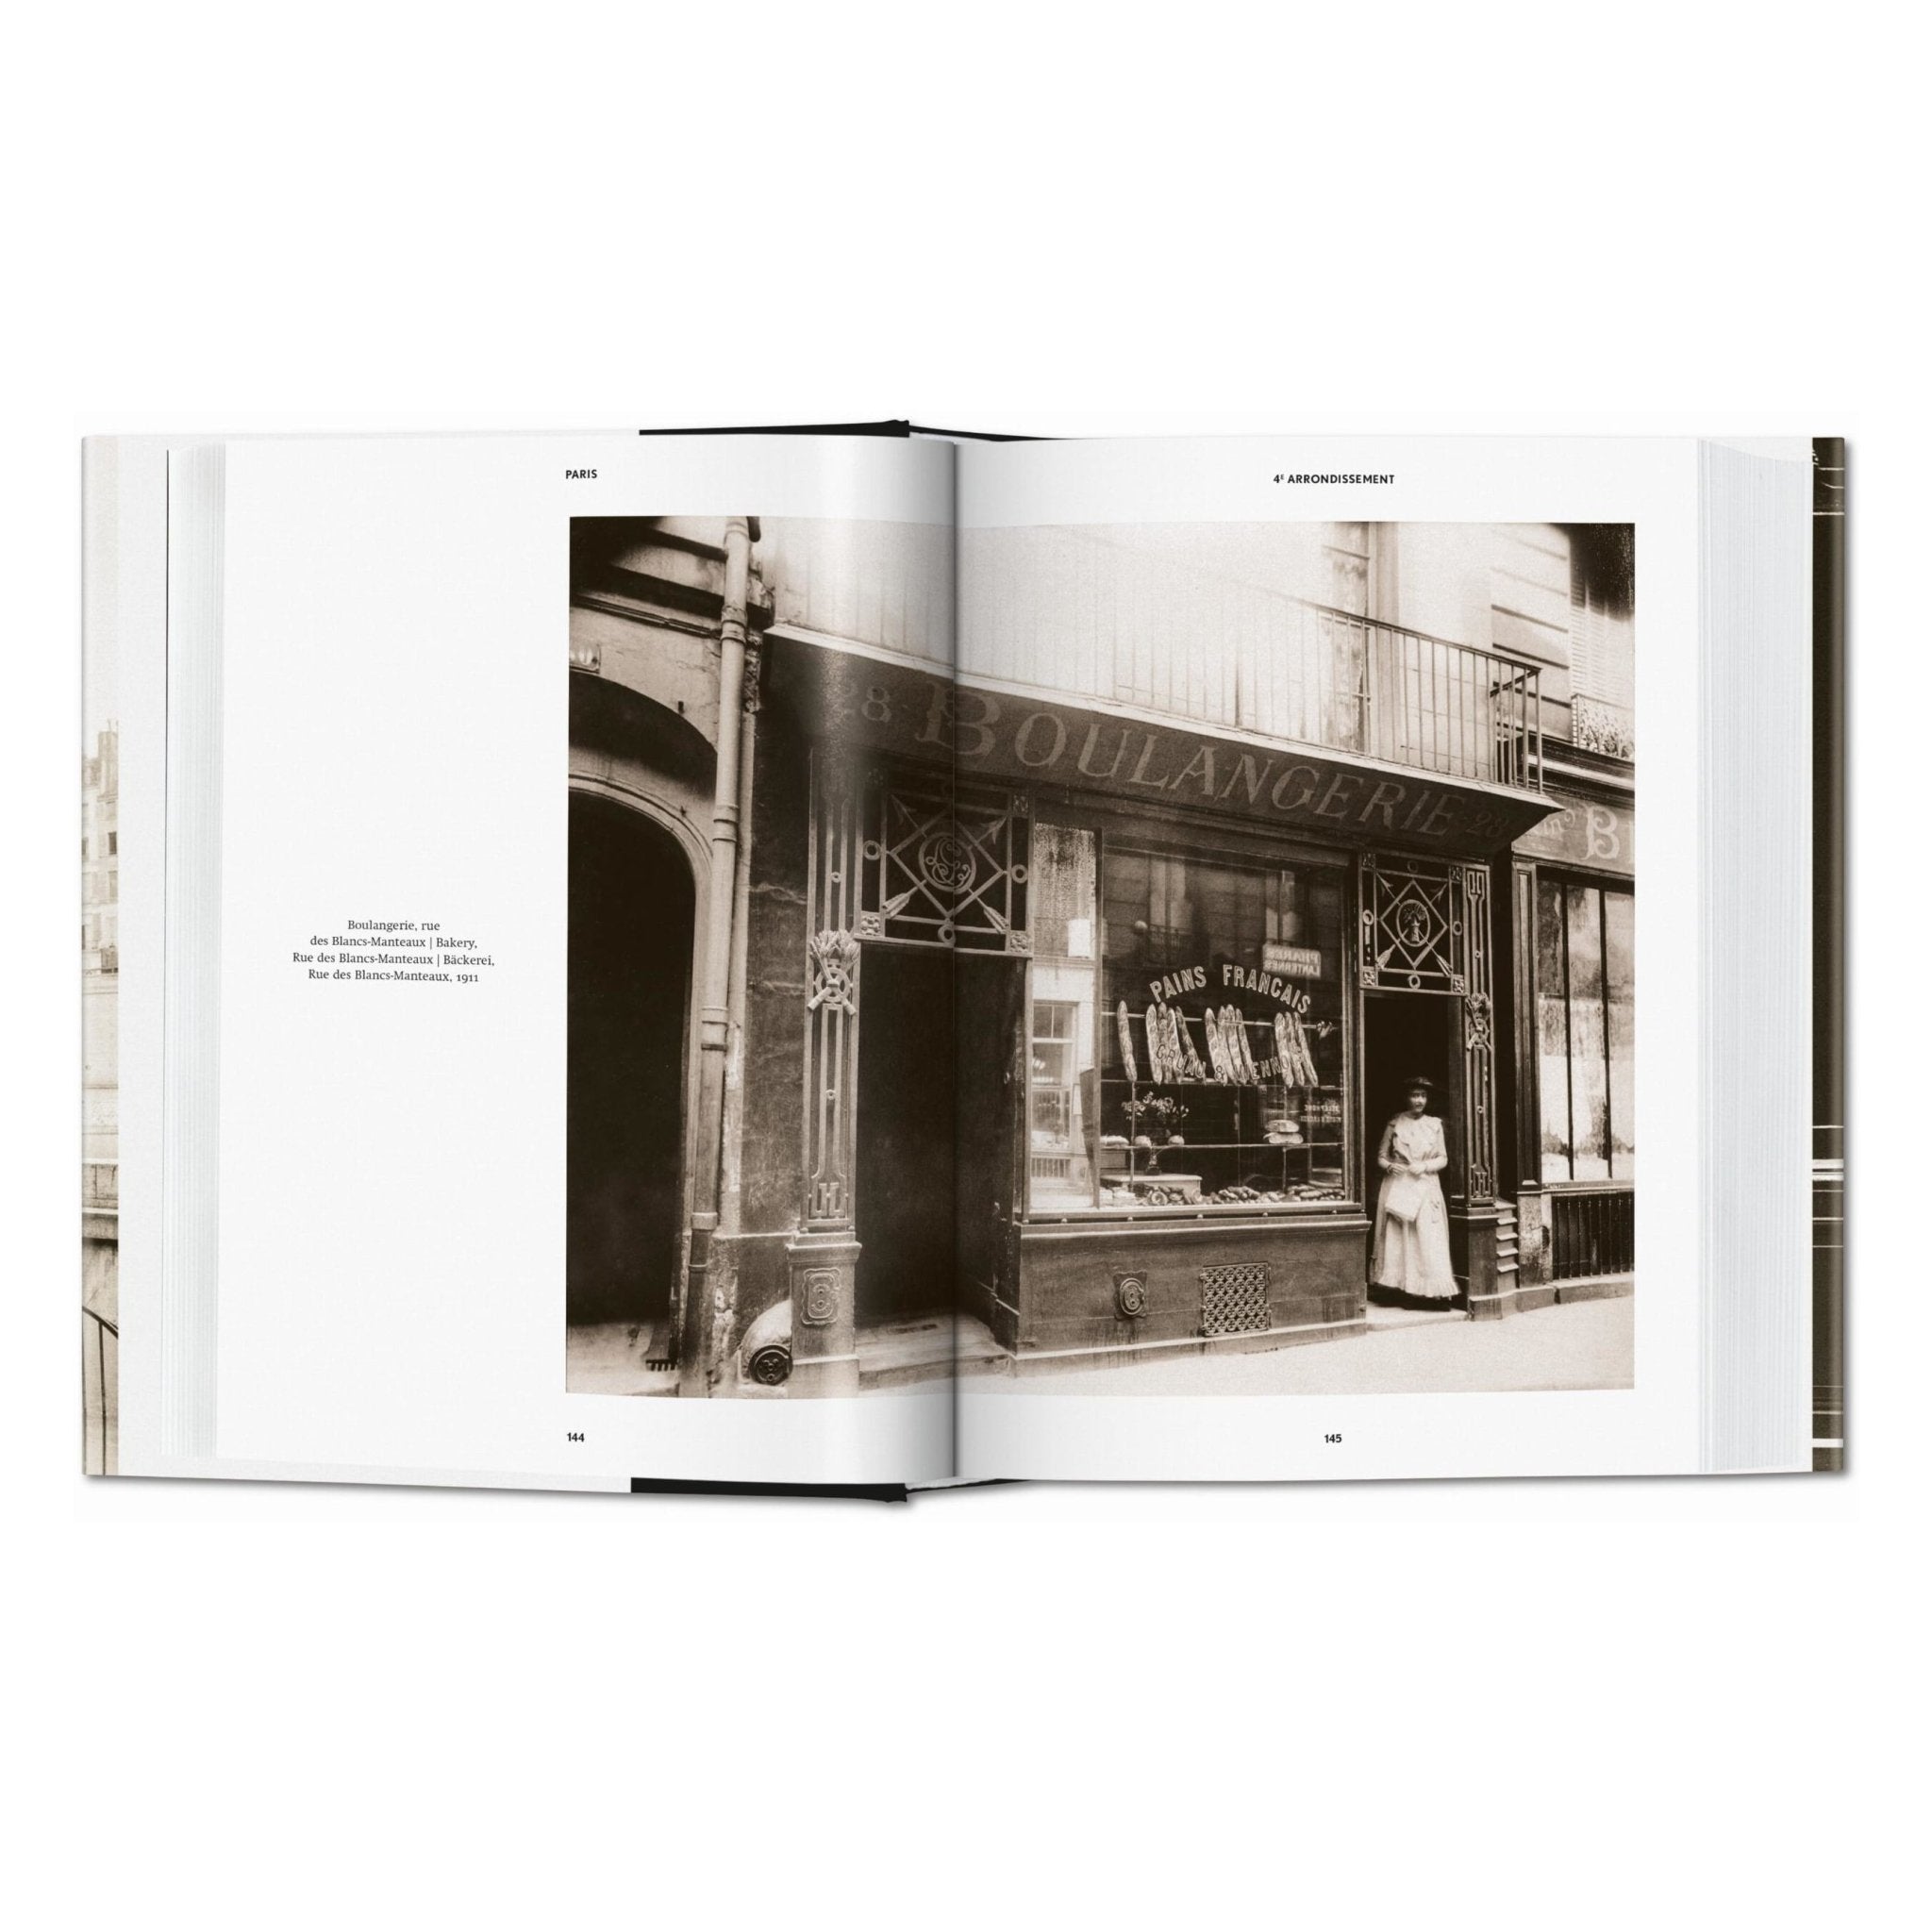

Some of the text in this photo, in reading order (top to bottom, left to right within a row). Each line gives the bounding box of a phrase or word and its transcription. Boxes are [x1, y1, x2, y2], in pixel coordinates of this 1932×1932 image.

[565, 469, 598, 479] PARIS
[1287, 474, 1395, 484] ARRONDISSEMENT
[913, 679, 1463, 837] BOULANGERIE
[347, 920, 441, 933] Boulangerie, rue
[309, 935, 329, 946] des
[332, 936, 426, 947] Blancs-Manteaux
[436, 937, 477, 951] Bakery,
[292, 952, 314, 963] Rue
[317, 952, 336, 963] des
[339, 953, 434, 965] Blancs-Manteaux
[443, 954, 495, 967] Bäckerei,
[308, 969, 479, 984] Rue des Blancs-Manteaux, 1911
[1149, 963, 1311, 1014] PAINS FRANCAIS
[567, 1432, 585, 1442] 144
[1324, 1433, 1342, 1443] 145
